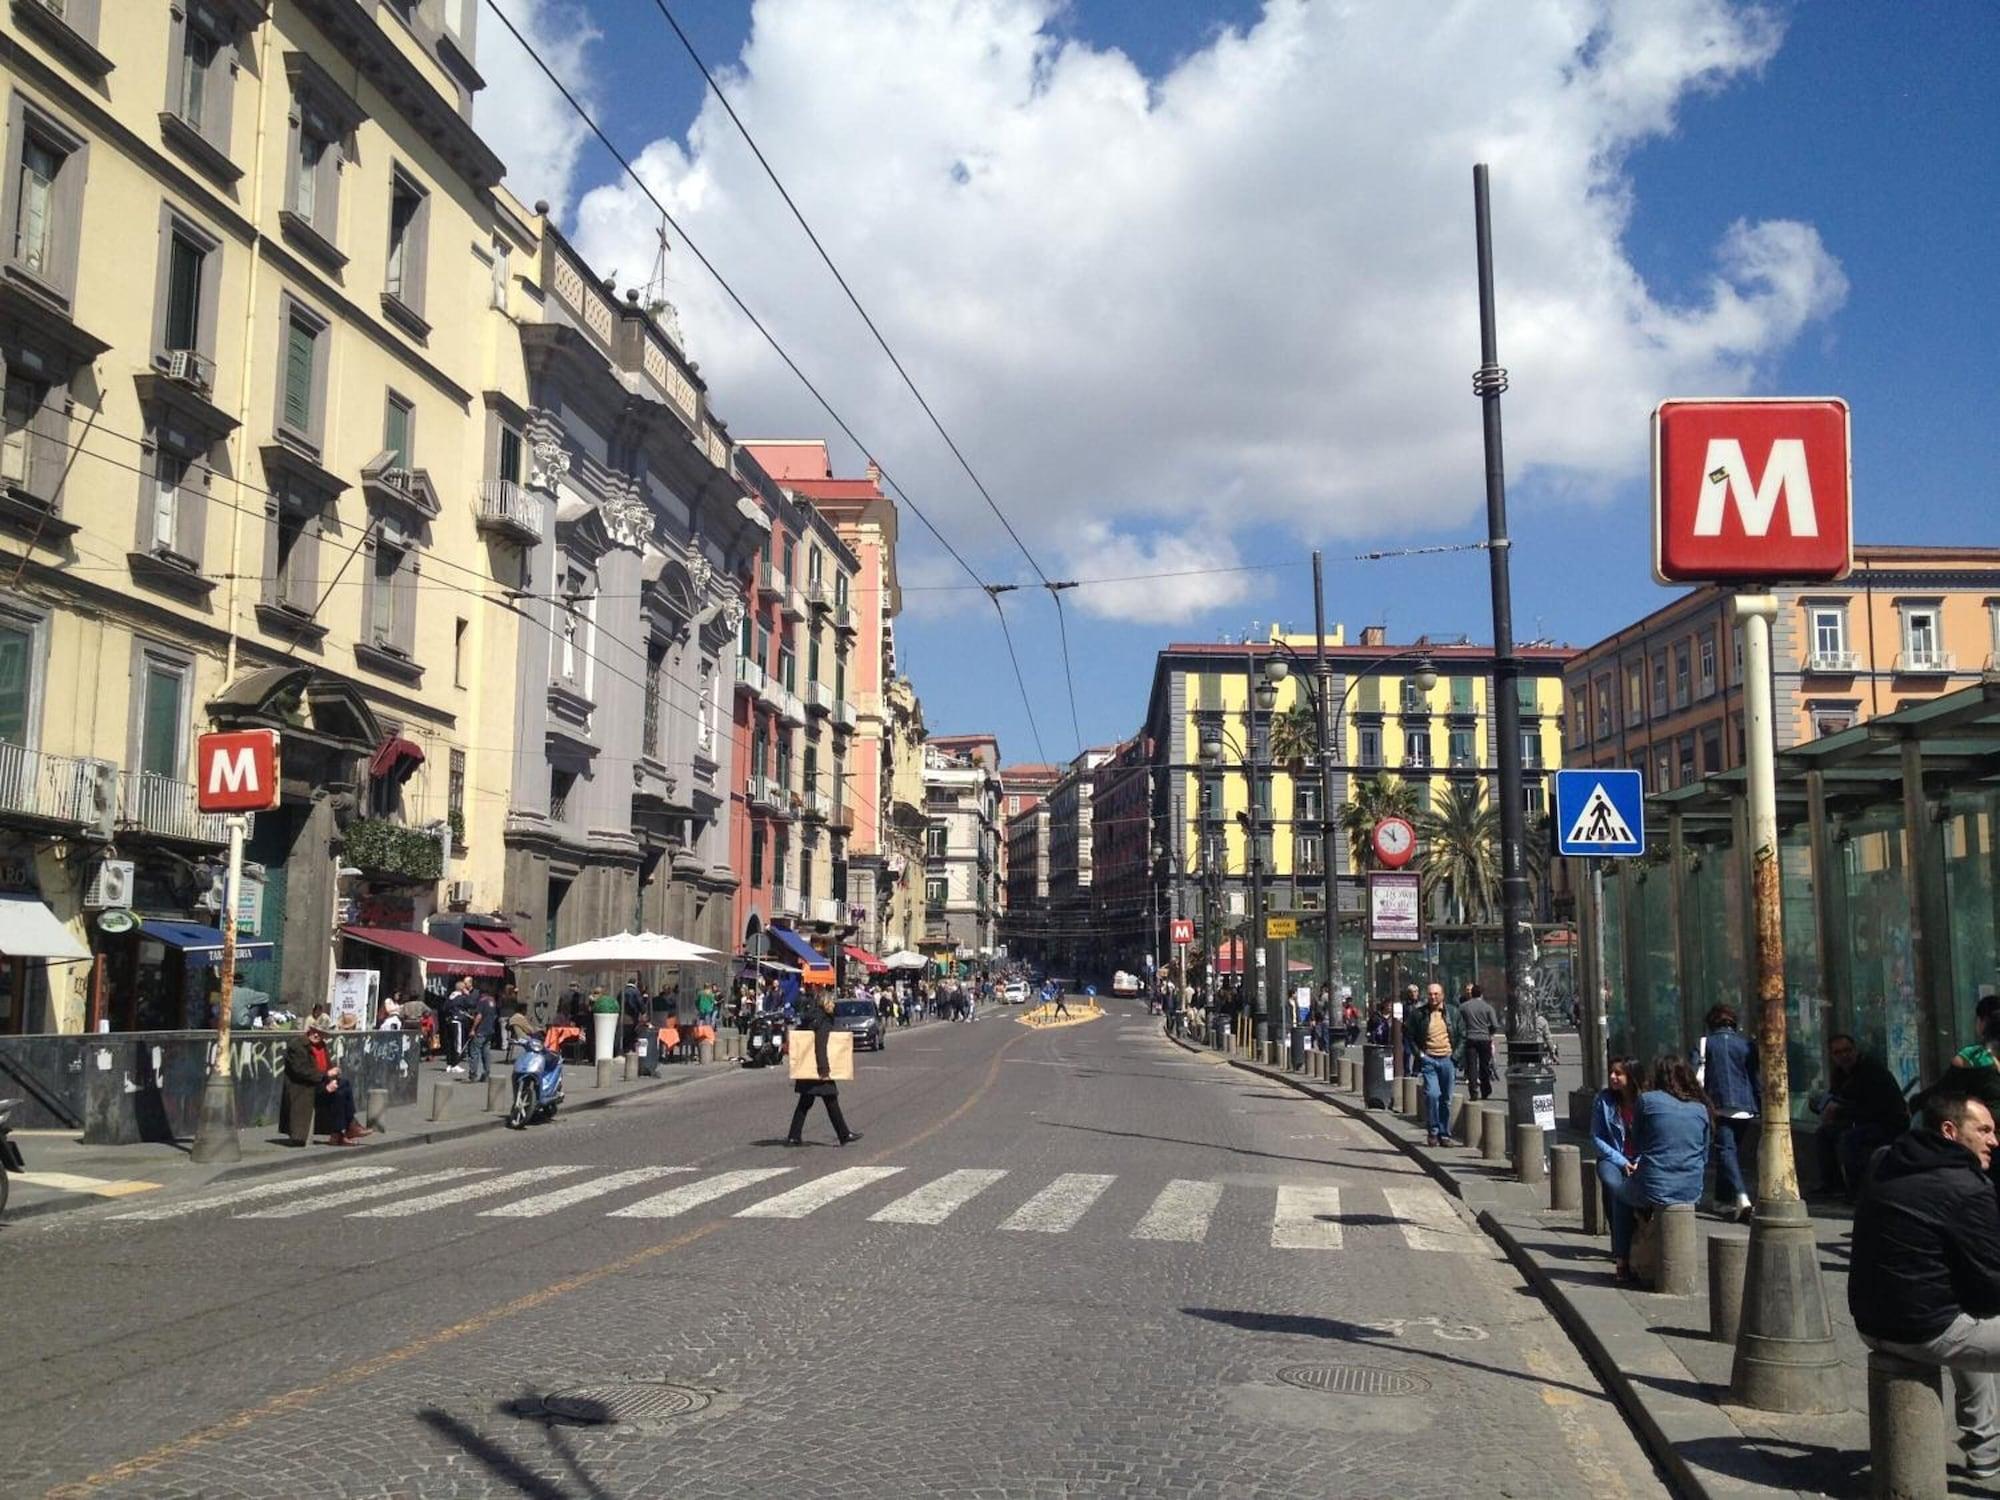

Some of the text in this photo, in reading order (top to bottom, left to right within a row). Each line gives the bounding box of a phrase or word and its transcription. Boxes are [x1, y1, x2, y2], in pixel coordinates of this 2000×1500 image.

[1693, 438, 1819, 537] M
[208, 747, 259, 794] M
[1175, 926, 1189, 938] M
